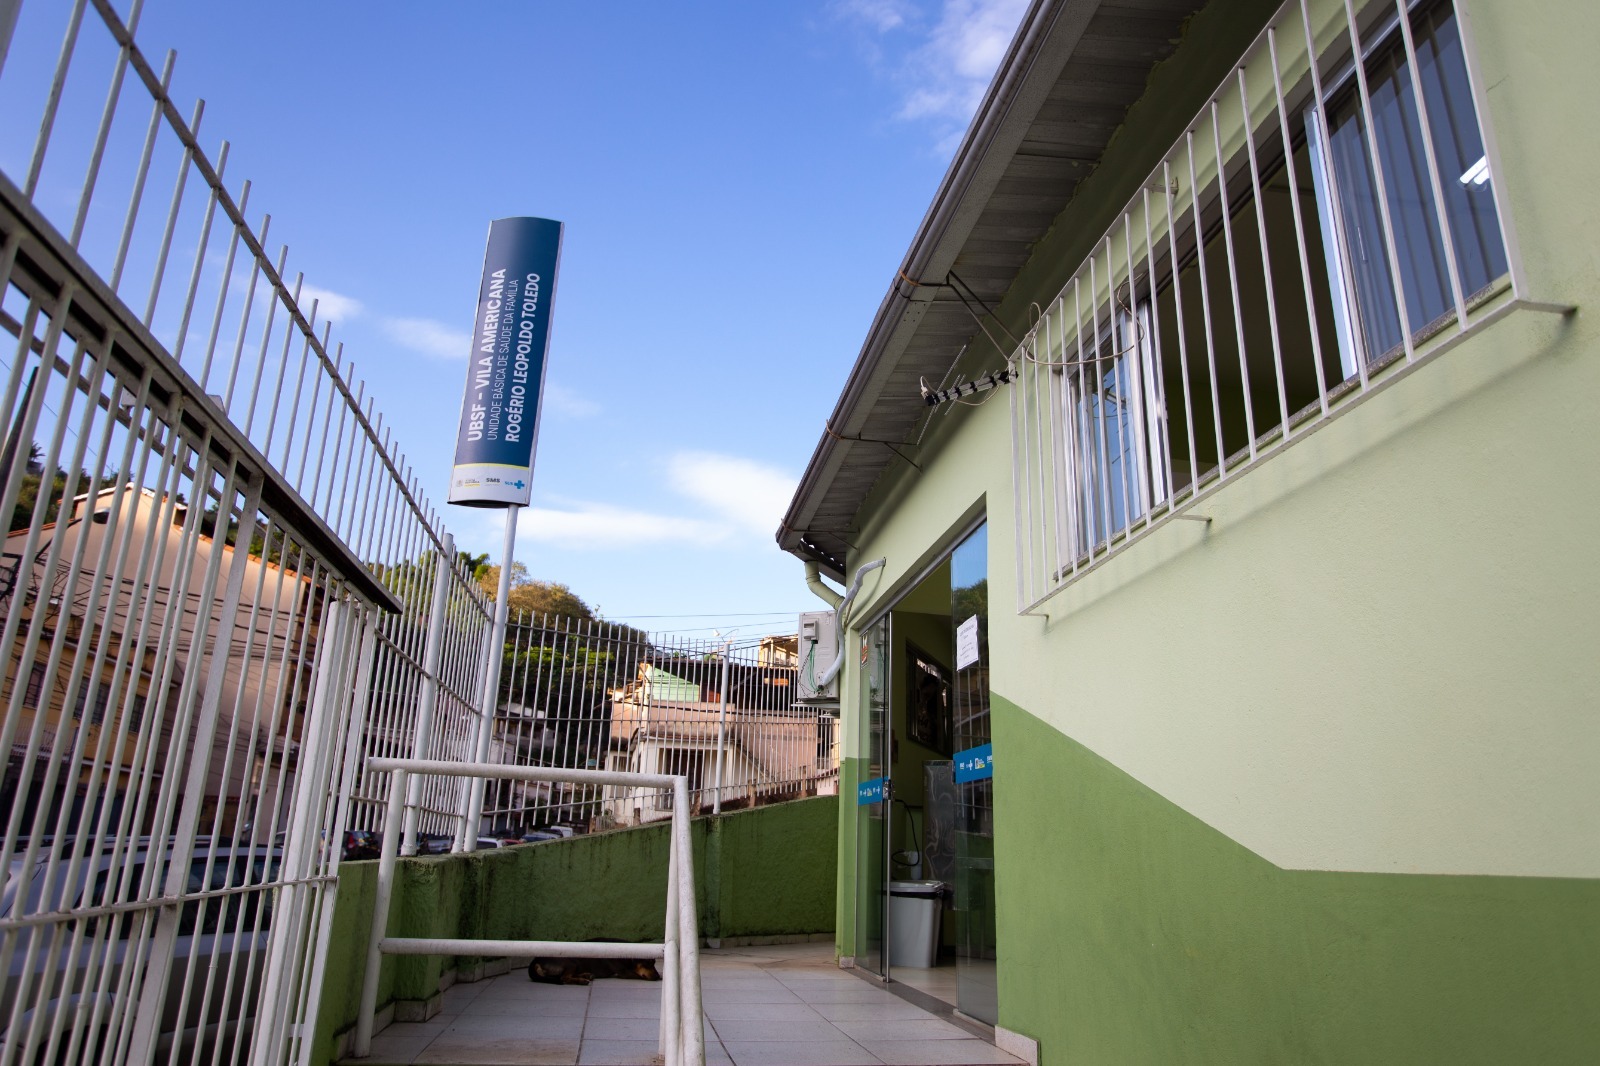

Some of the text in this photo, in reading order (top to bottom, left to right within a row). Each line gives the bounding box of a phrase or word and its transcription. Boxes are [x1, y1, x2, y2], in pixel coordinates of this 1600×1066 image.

[481, 268, 507, 353] AMERICANA
[475, 356, 493, 390] VILA
[487, 279, 519, 441] UNIDADE BÁSICA DE SAÚDE DA FAMÍLIA
[505, 273, 540, 442] ROGÉRIO LEOPOLDO TOLEDO
[468, 404, 486, 442] UBSF
